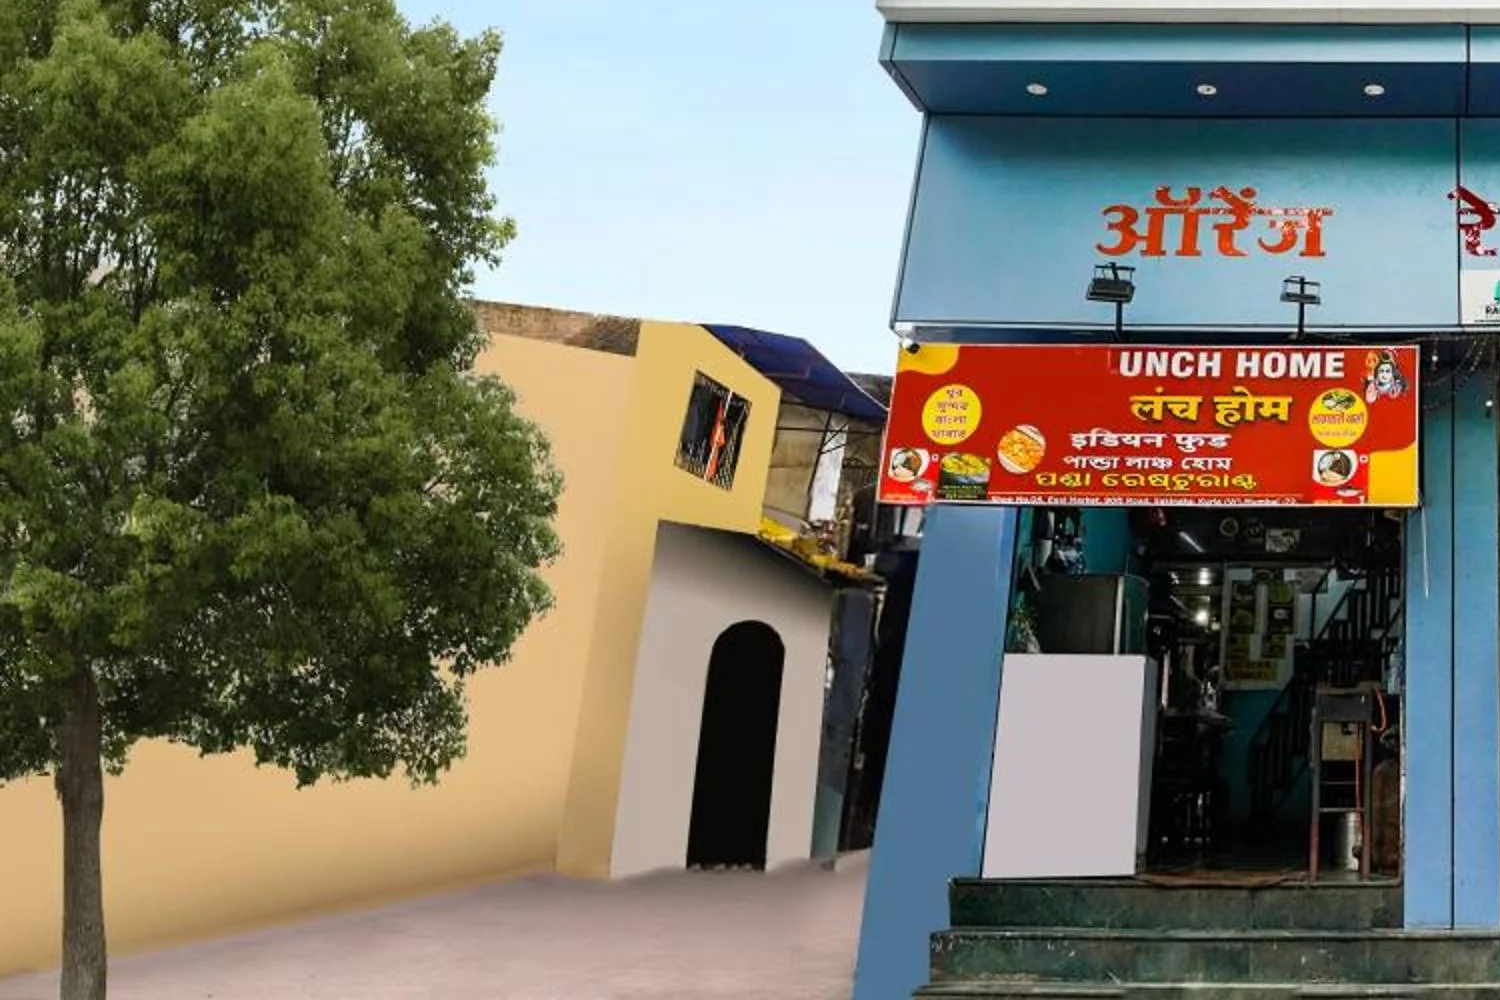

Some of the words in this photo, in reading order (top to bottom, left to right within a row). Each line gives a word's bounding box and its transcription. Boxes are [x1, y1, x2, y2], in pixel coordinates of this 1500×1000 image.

[1235, 351, 1345, 379] HOME
[1129, 387, 1203, 421] लंच
[1213, 386, 1293, 427] होम
